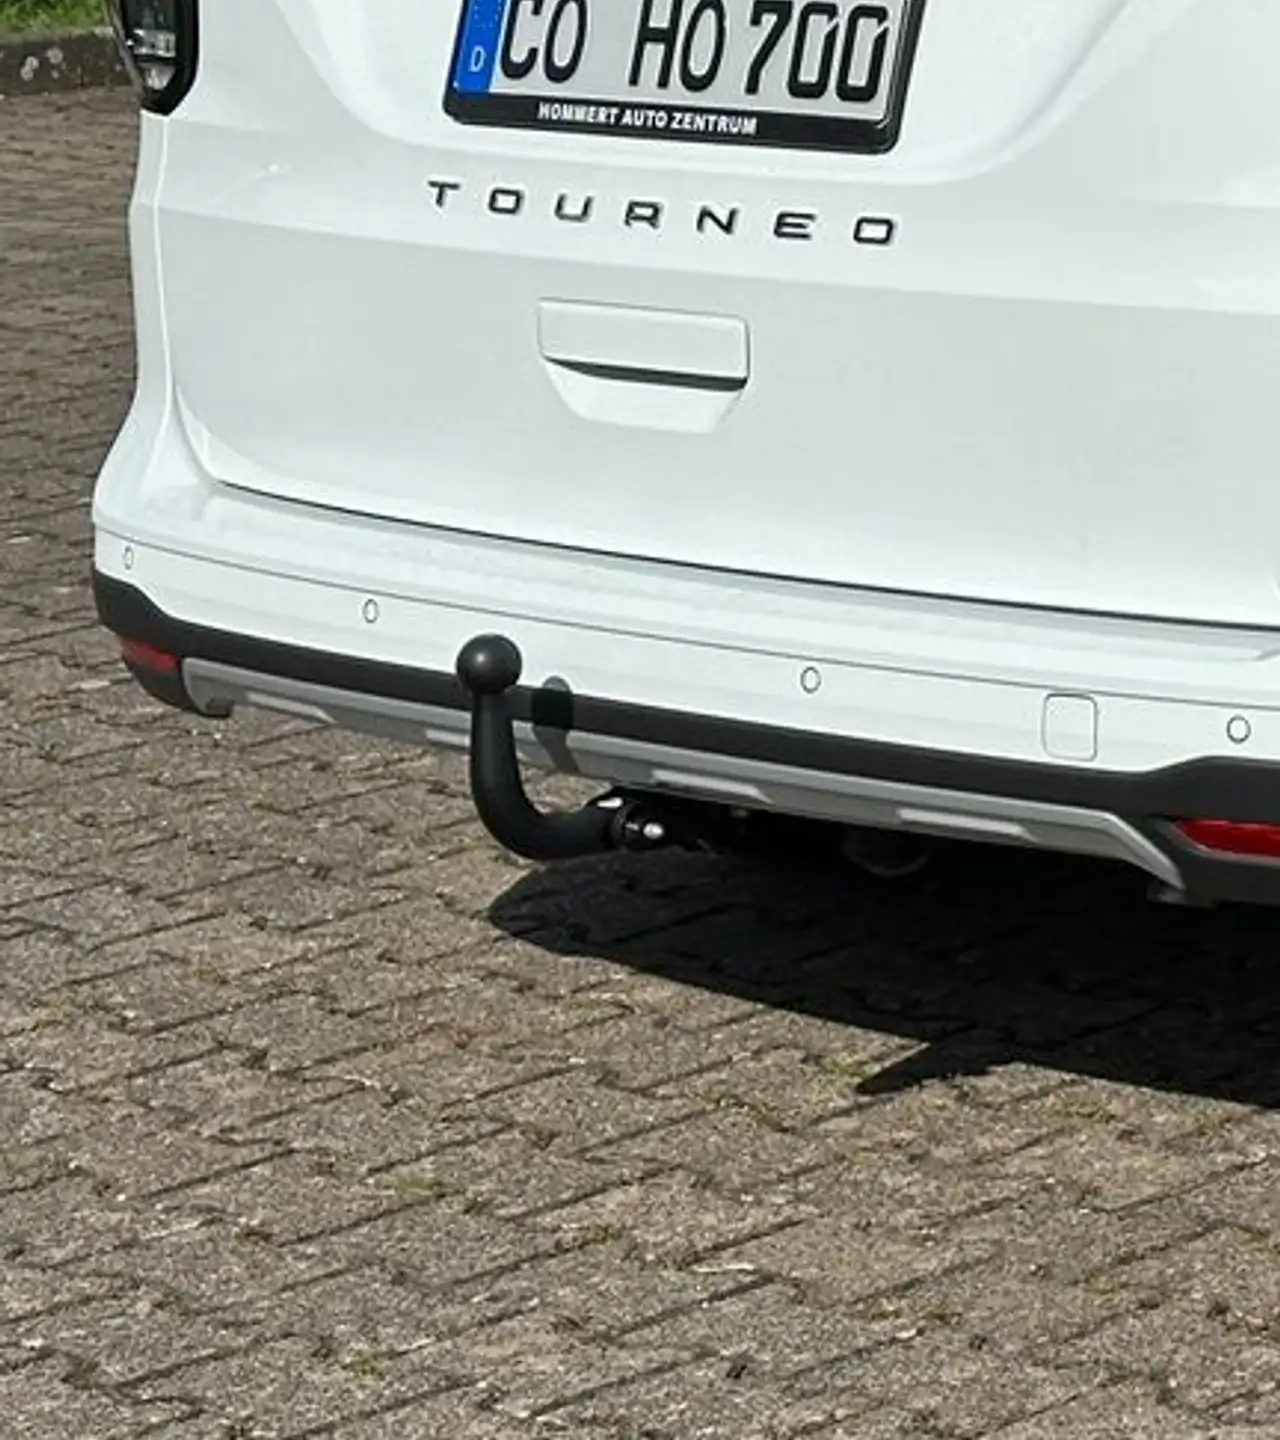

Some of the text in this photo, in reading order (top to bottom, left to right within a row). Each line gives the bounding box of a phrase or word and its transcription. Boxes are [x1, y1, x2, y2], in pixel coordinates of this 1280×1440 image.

[468, 44, 485, 74] D
[537, 101, 758, 136] HOMMERT AUTO ZENTRUM
[427, 180, 896, 246] TOURNEO
